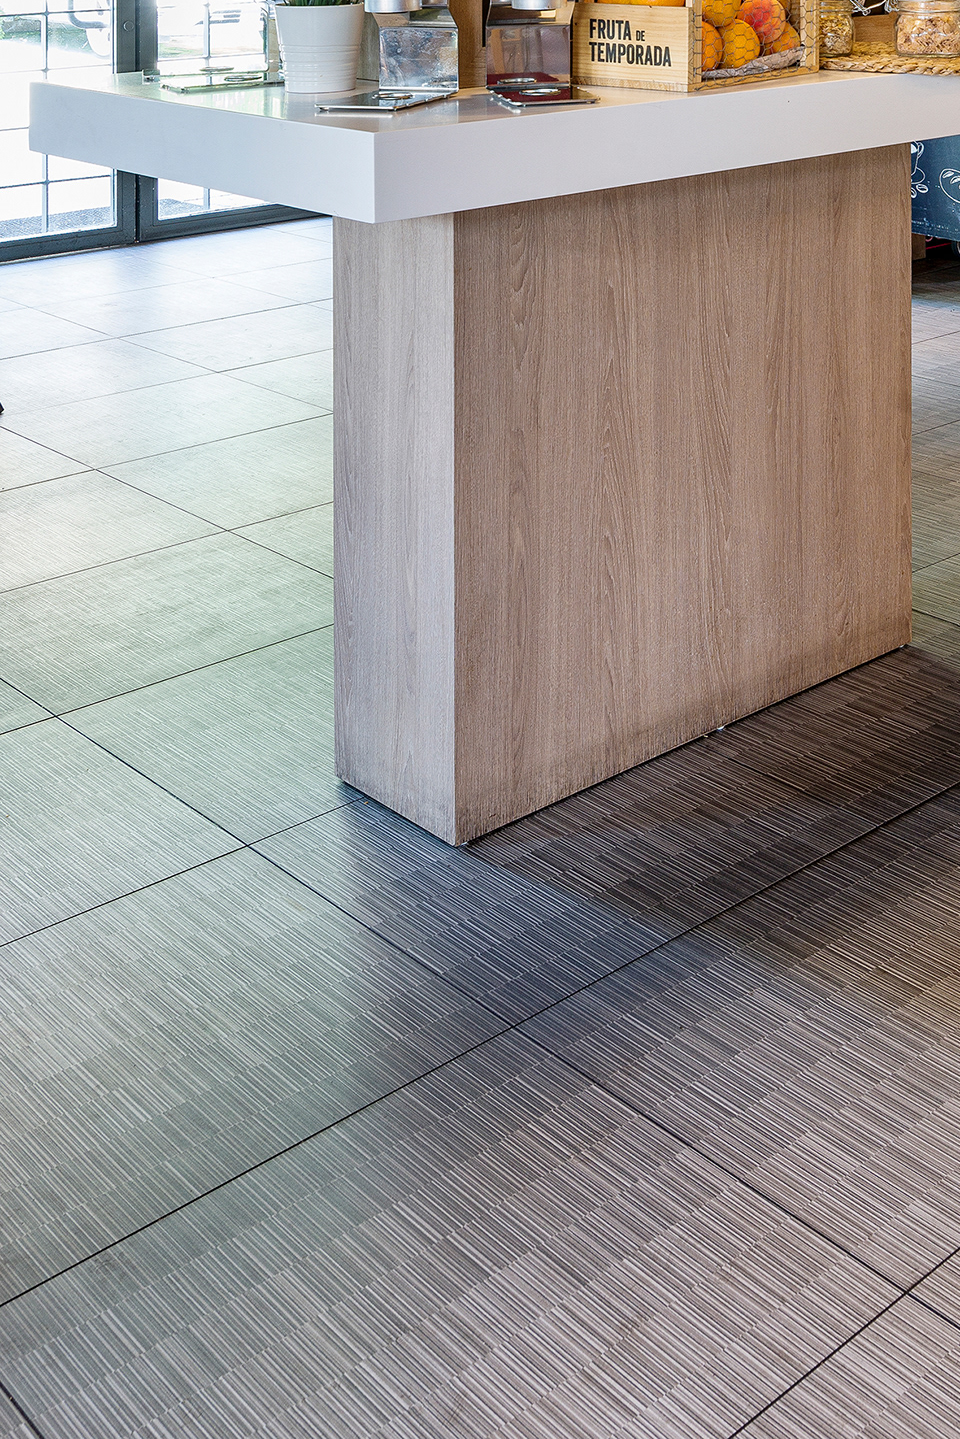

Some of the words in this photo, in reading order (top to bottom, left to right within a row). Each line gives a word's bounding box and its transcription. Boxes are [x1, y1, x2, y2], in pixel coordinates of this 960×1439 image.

[590, 18, 632, 41] FRUTA
[636, 30, 645, 41] DE
[589, 42, 672, 67] TEMPORADA
